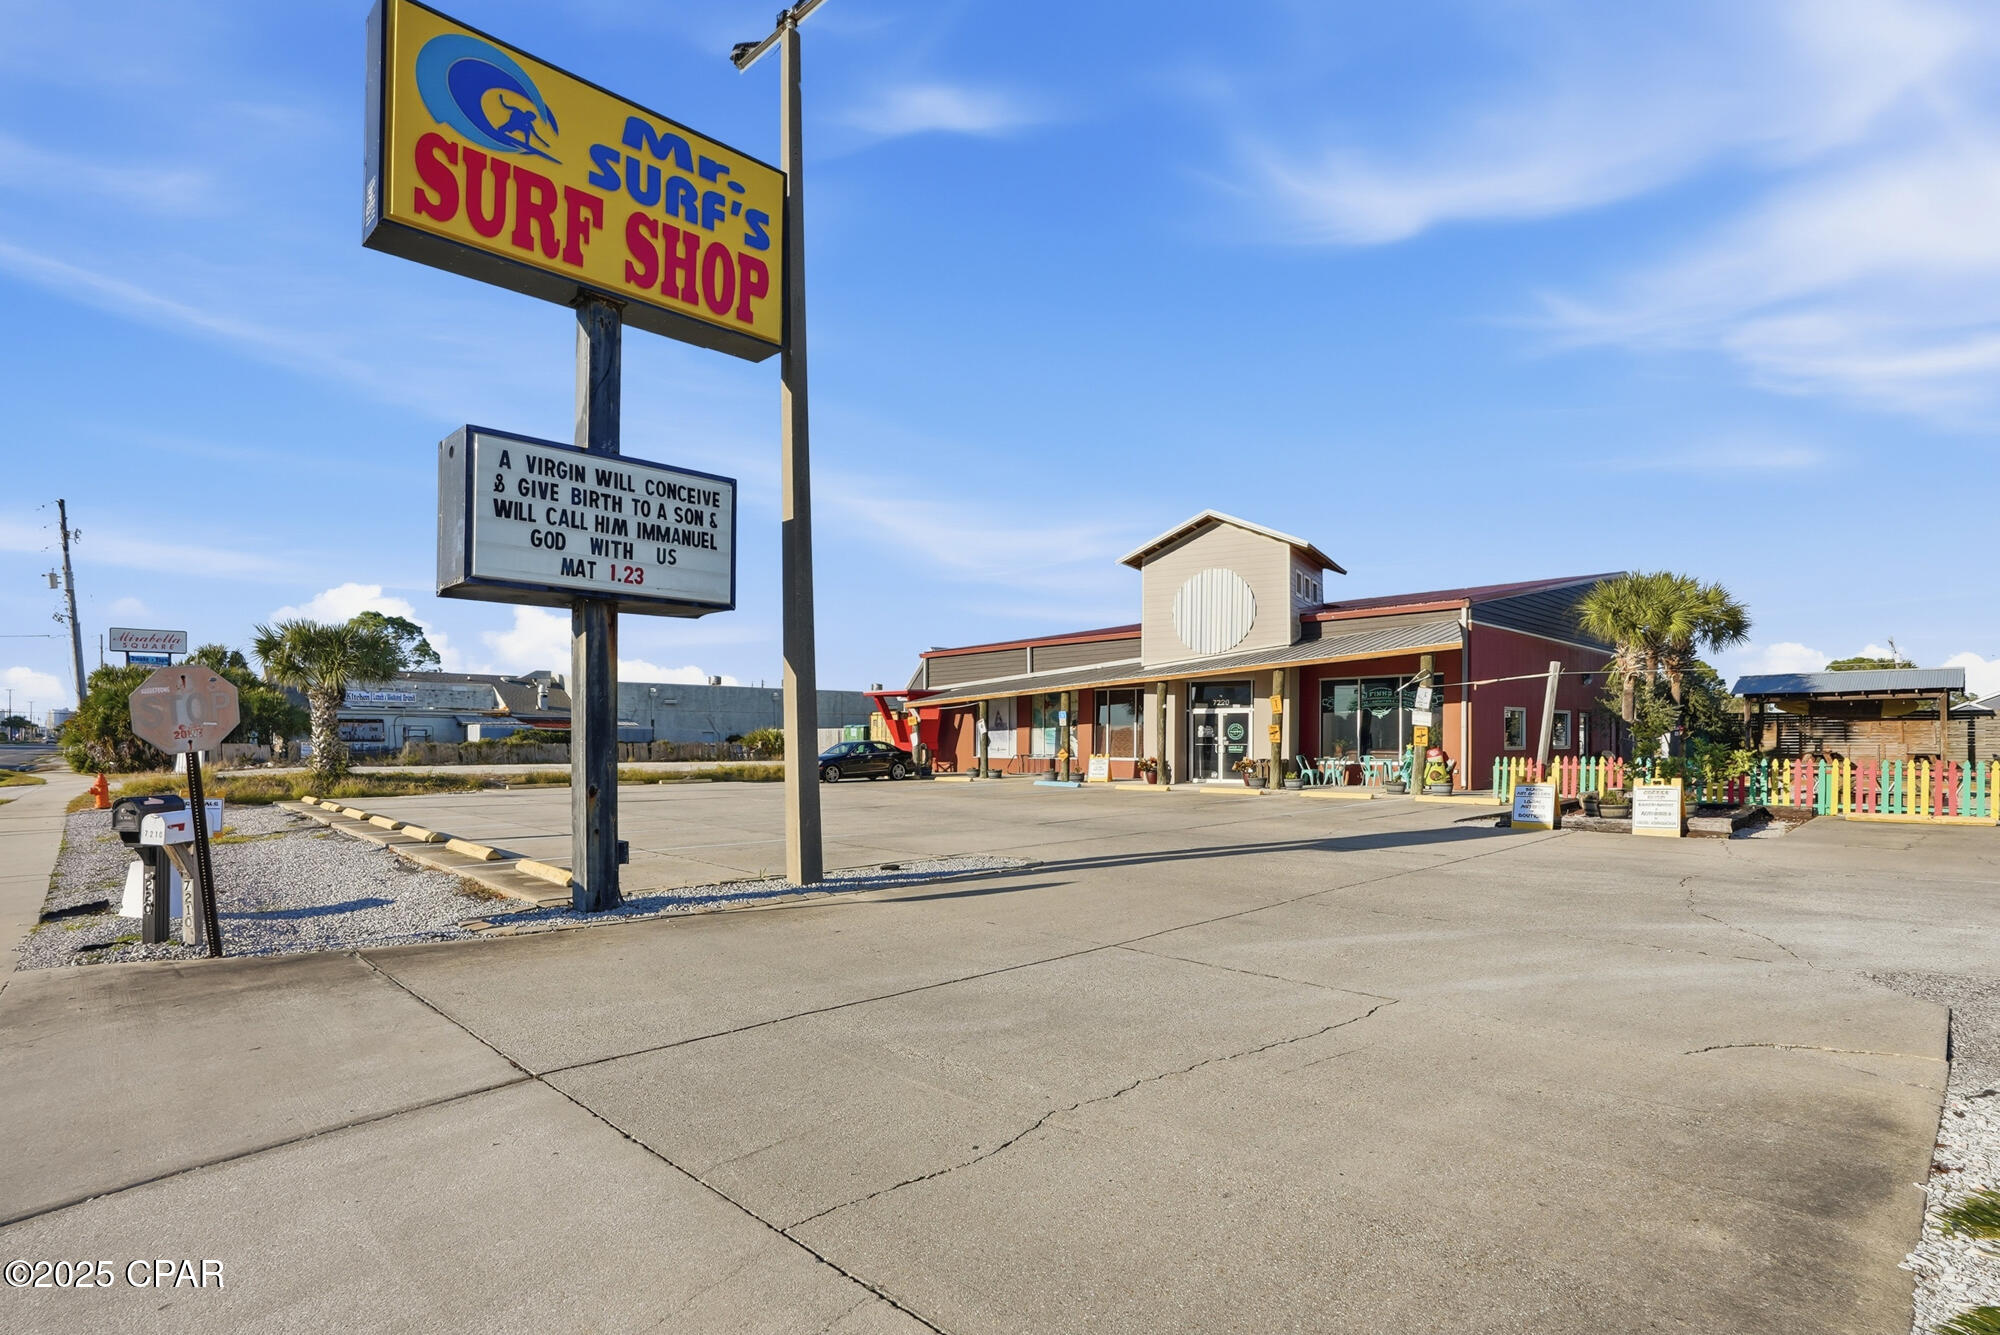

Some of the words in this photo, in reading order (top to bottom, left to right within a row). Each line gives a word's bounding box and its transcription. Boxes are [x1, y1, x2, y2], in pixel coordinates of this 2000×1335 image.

[622, 116, 746, 194] Mr.
[588, 144, 770, 251] SURF'S
[413, 132, 604, 268] SURF
[624, 211, 770, 324] SHOP
[493, 473, 505, 493] &
[518, 478, 560, 503] GIVE
[571, 486, 623, 514] BIRTH
[632, 497, 652, 518] TO
[656, 502, 668, 521] A
[674, 506, 704, 527] SON
[709, 511, 718, 529] &
[499, 449, 512, 470] A
[526, 454, 586, 484] VIRGIN
[595, 468, 636, 493] WILL
[645, 479, 721, 509] CONCEIVE
[493, 498, 537, 523] WILL
[546, 507, 589, 531] CALL
[595, 514, 629, 538] HIM
[637, 521, 718, 551] IMMANUEL
[530, 529, 567, 551] GOD
[590, 536, 634, 561] WITH
[656, 546, 677, 566] US
[561, 557, 597, 580] MAT
[610, 563, 645, 585] 1.23
[113, 632, 182, 644] Mirabella
[122, 642, 175, 651] SQUARE
[141, 691, 230, 728] STOP
[144, 830, 163, 839] 7210
[183, 880, 194, 928] 7210
